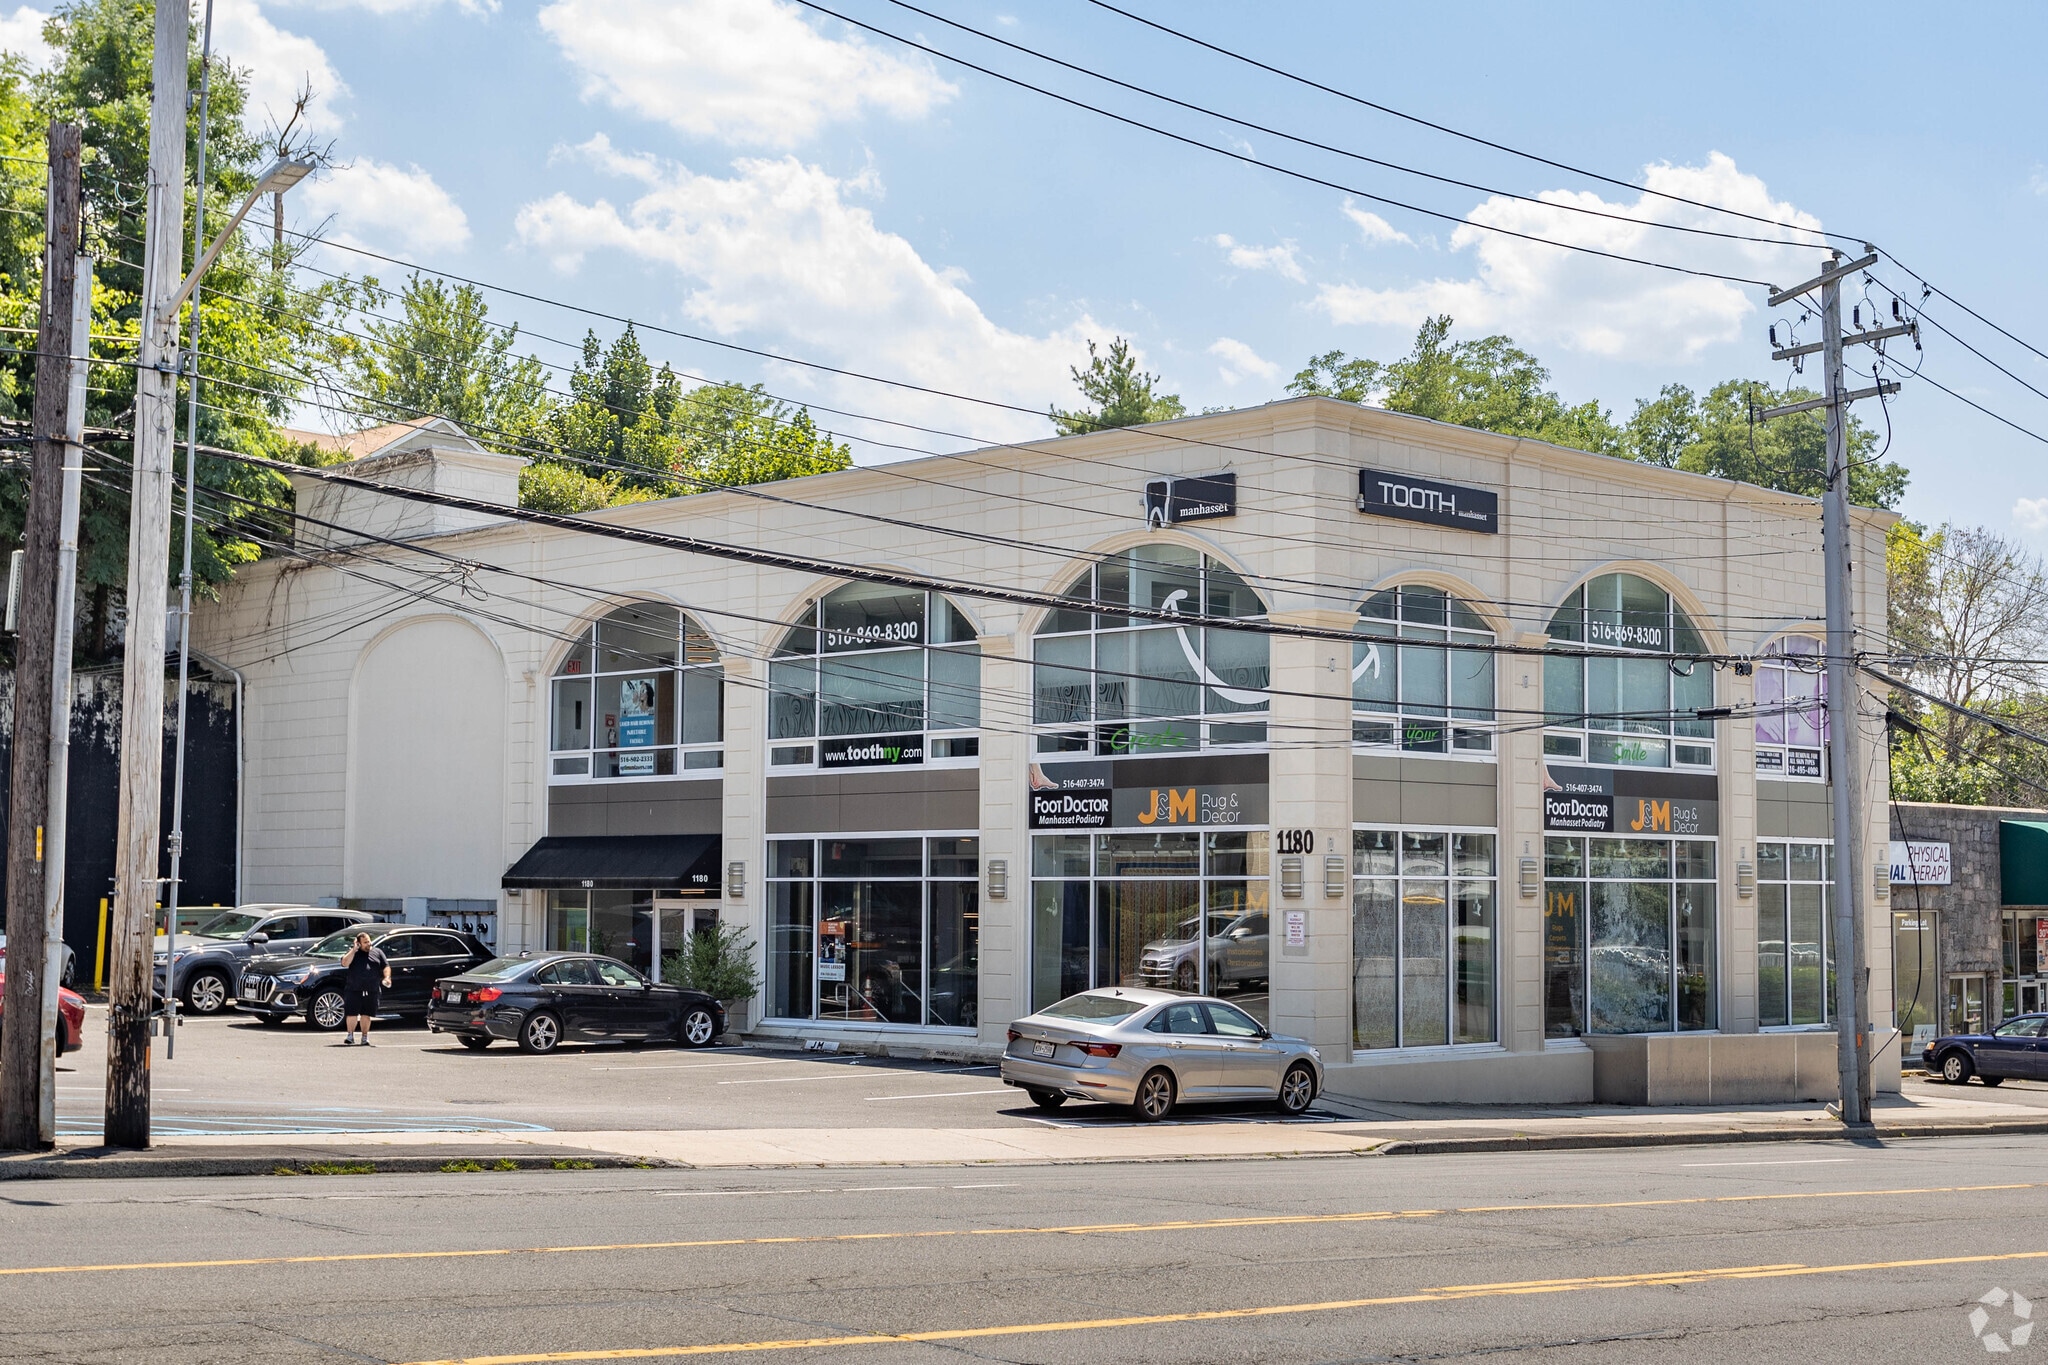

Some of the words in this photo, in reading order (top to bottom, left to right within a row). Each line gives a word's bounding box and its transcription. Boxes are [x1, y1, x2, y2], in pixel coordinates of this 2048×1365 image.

[1378, 481, 1456, 515] TOOTH
[1180, 503, 1228, 517] manhasset
[1458, 510, 1488, 521] manhasset
[828, 621, 918, 646] 516-869-8300
[1592, 621, 1662, 646] 516-869-8300
[567, 660, 582, 672] EXIT
[1111, 724, 1185, 750] Create
[1406, 724, 1438, 748] Your
[825, 744, 922, 763] www.toothny.com
[1612, 742, 1648, 762] Smile
[1062, 778, 1104, 788] 516-407-3474
[1566, 784, 1602, 794] 516-407-3474
[1034, 796, 1062, 814] FOOT
[1064, 796, 1108, 813] DOCTOR
[1138, 788, 1196, 824] J&M
[1202, 794, 1226, 810] Rug
[1230, 793, 1239, 808] &
[1546, 798, 1570, 816] FOOT
[1572, 800, 1608, 818] DOCTOR
[1038, 814, 1075, 825] Manhasset
[1076, 814, 1104, 826] Podiatry
[1202, 810, 1240, 824] Decor
[1630, 800, 1670, 832] J&M
[1674, 807, 1690, 820] Rug
[1692, 808, 1698, 820] &
[1550, 817, 1582, 828] Manhasset
[1582, 818, 1606, 830] Podiatry
[1674, 820, 1698, 833] Decor
[1277, 830, 1314, 854] 1180
[1908, 846, 1948, 862] PHYSICAL
[692, 874, 708, 882] 1180
[1908, 865, 1948, 880] THERAPY
[1902, 918, 1919, 928] Parking
